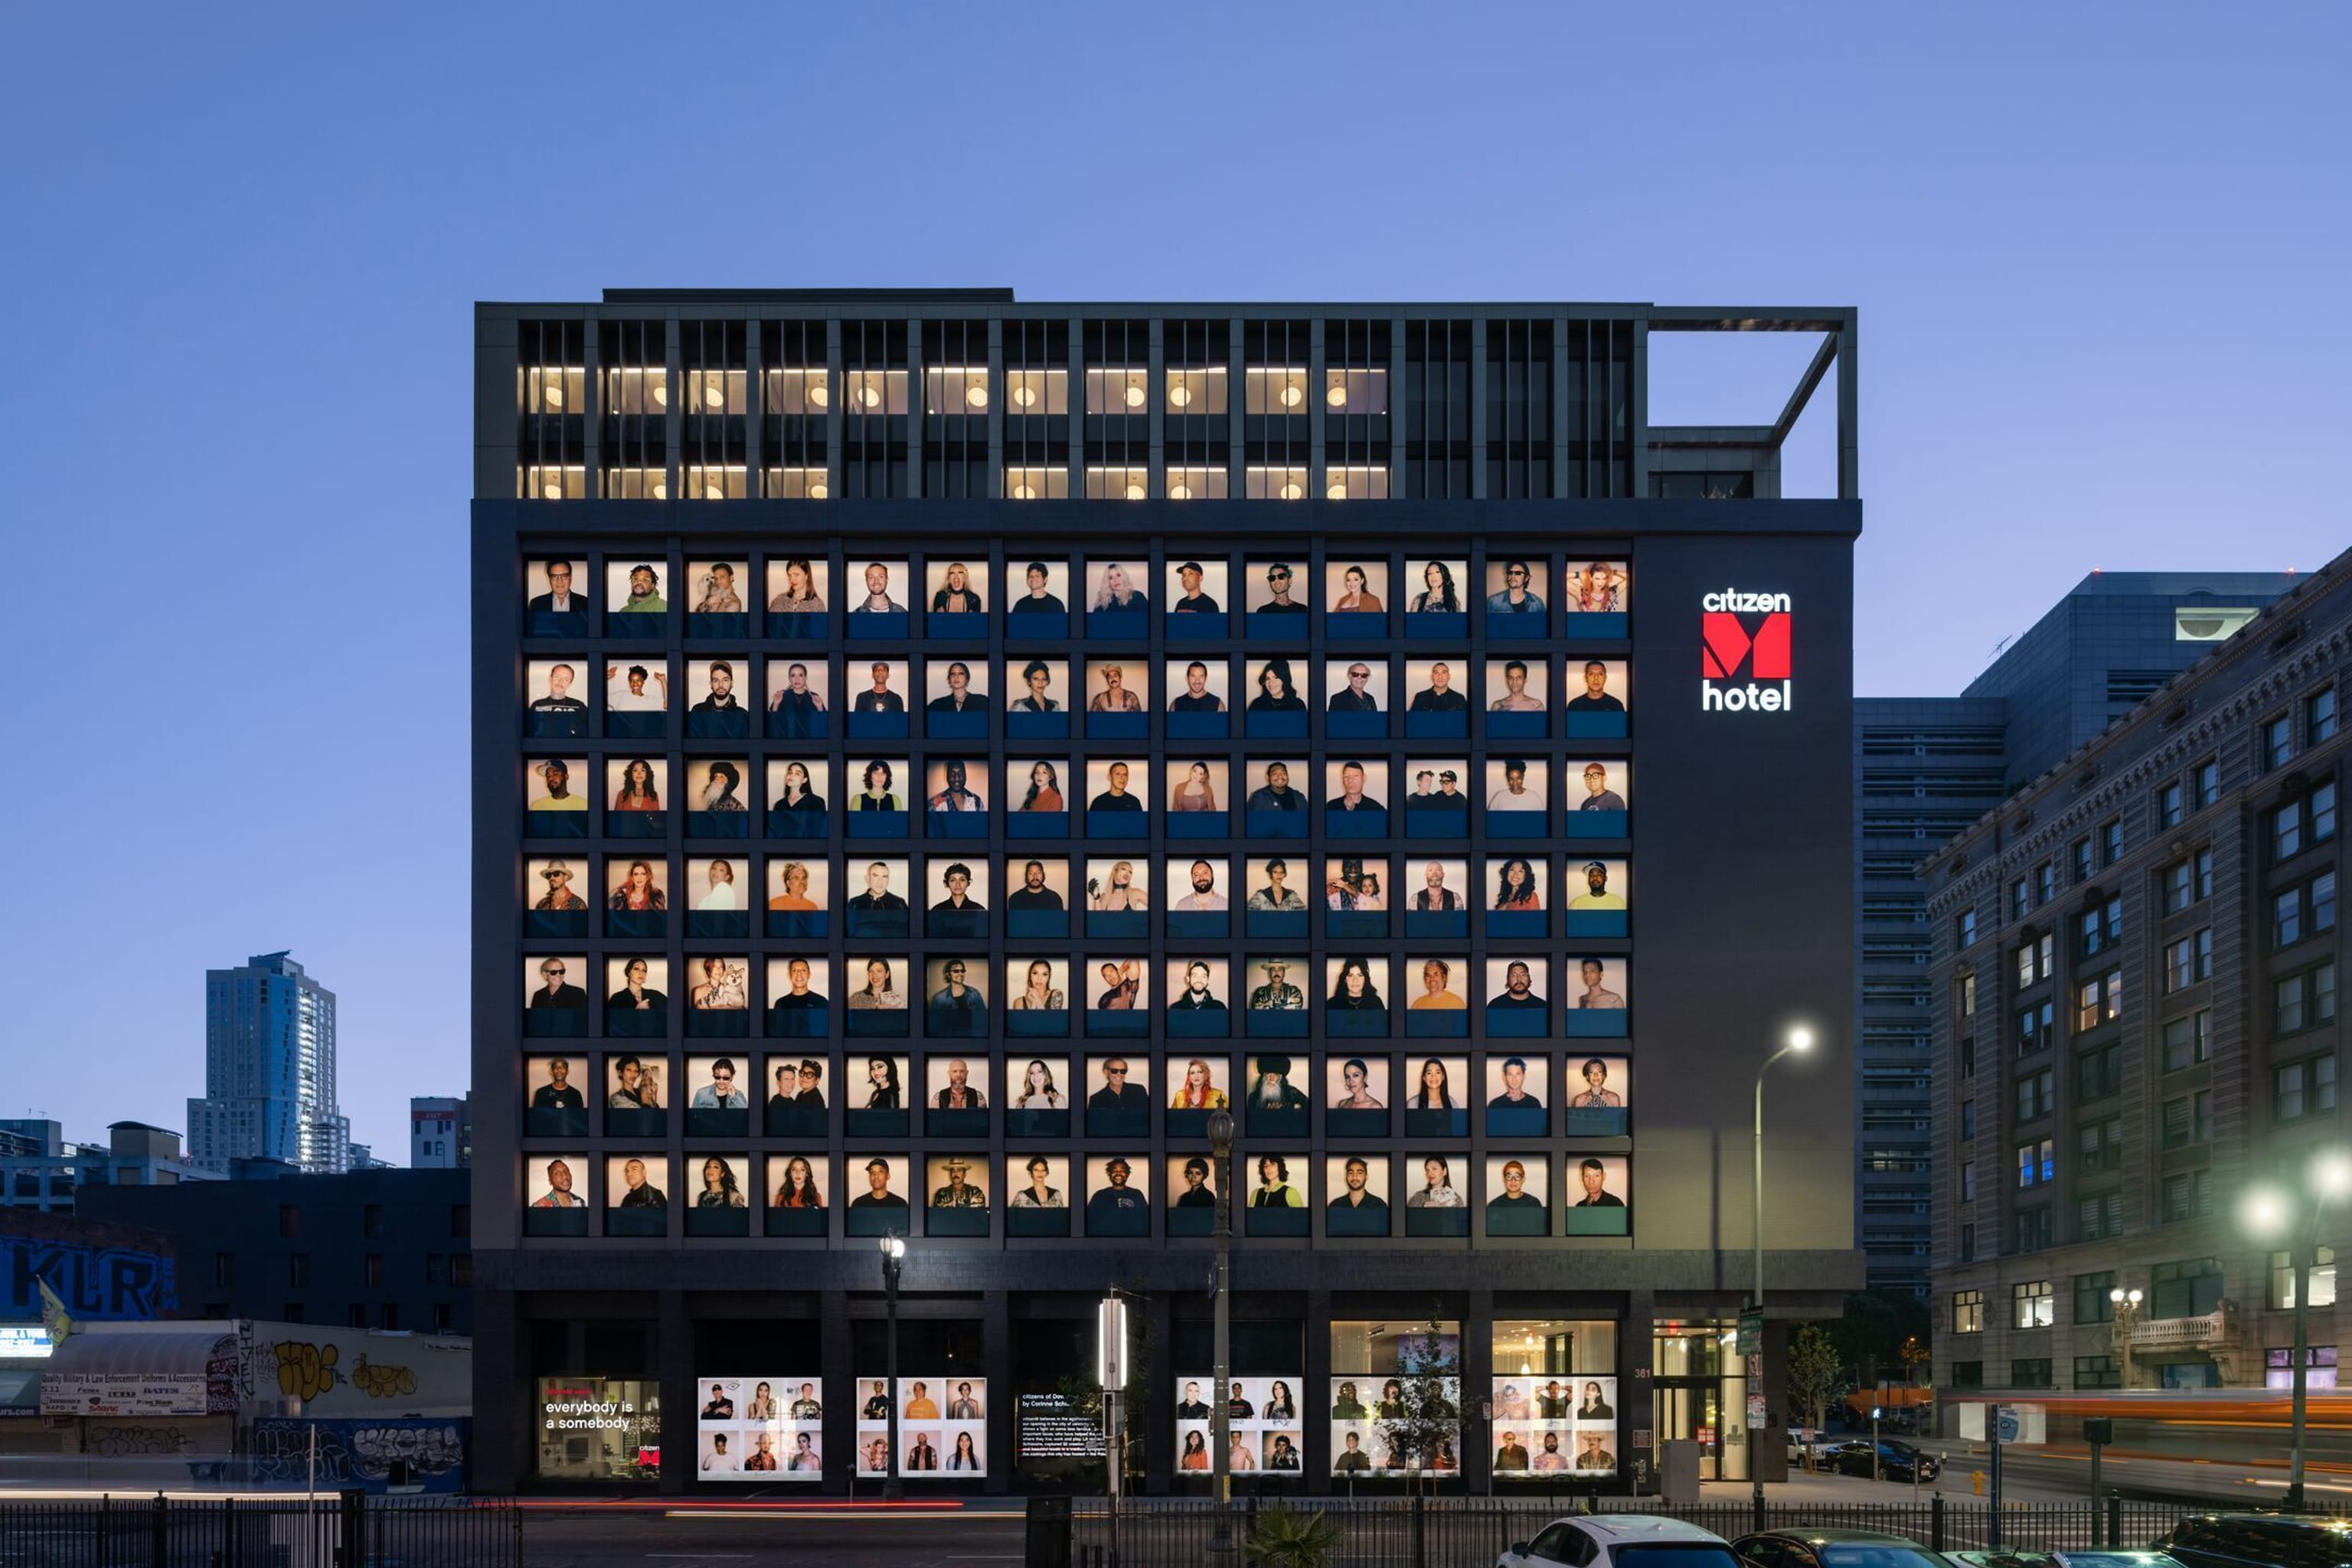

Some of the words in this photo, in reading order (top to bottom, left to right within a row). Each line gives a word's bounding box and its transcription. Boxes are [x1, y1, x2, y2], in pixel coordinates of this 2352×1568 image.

[1703, 587, 1791, 612] citizen
[1703, 679, 1791, 711] hotel
[42, 1374, 61, 1384] Quality
[92, 1374, 105, 1383] Law
[106, 1373, 140, 1383] Enforcement
[142, 1372, 167, 1383] Uniforms
[1635, 1368, 1651, 1378] 361
[546, 1400, 617, 1416] everybody
[622, 1401, 633, 1413] is
[546, 1419, 554, 1429] a
[559, 1417, 629, 1432] somebody
